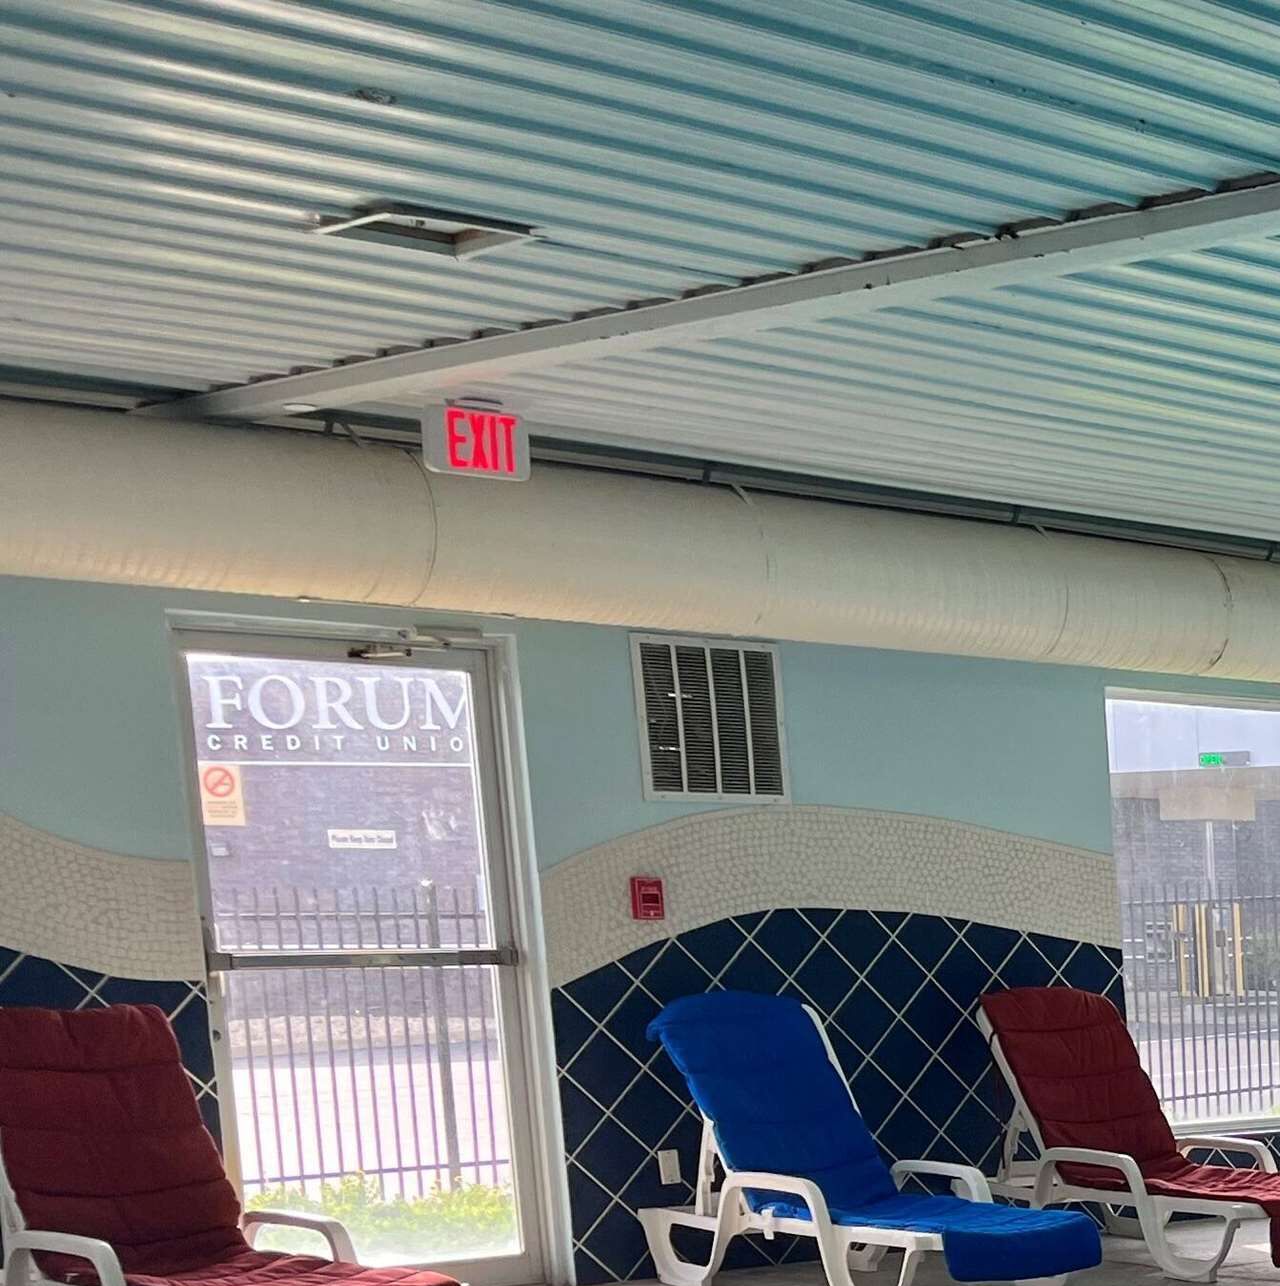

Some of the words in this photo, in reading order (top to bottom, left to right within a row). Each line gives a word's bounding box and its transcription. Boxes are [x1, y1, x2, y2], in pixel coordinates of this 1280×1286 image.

[446, 408, 516, 474] EXIT
[201, 674, 468, 730] FORUM
[206, 734, 344, 751] CREDIT
